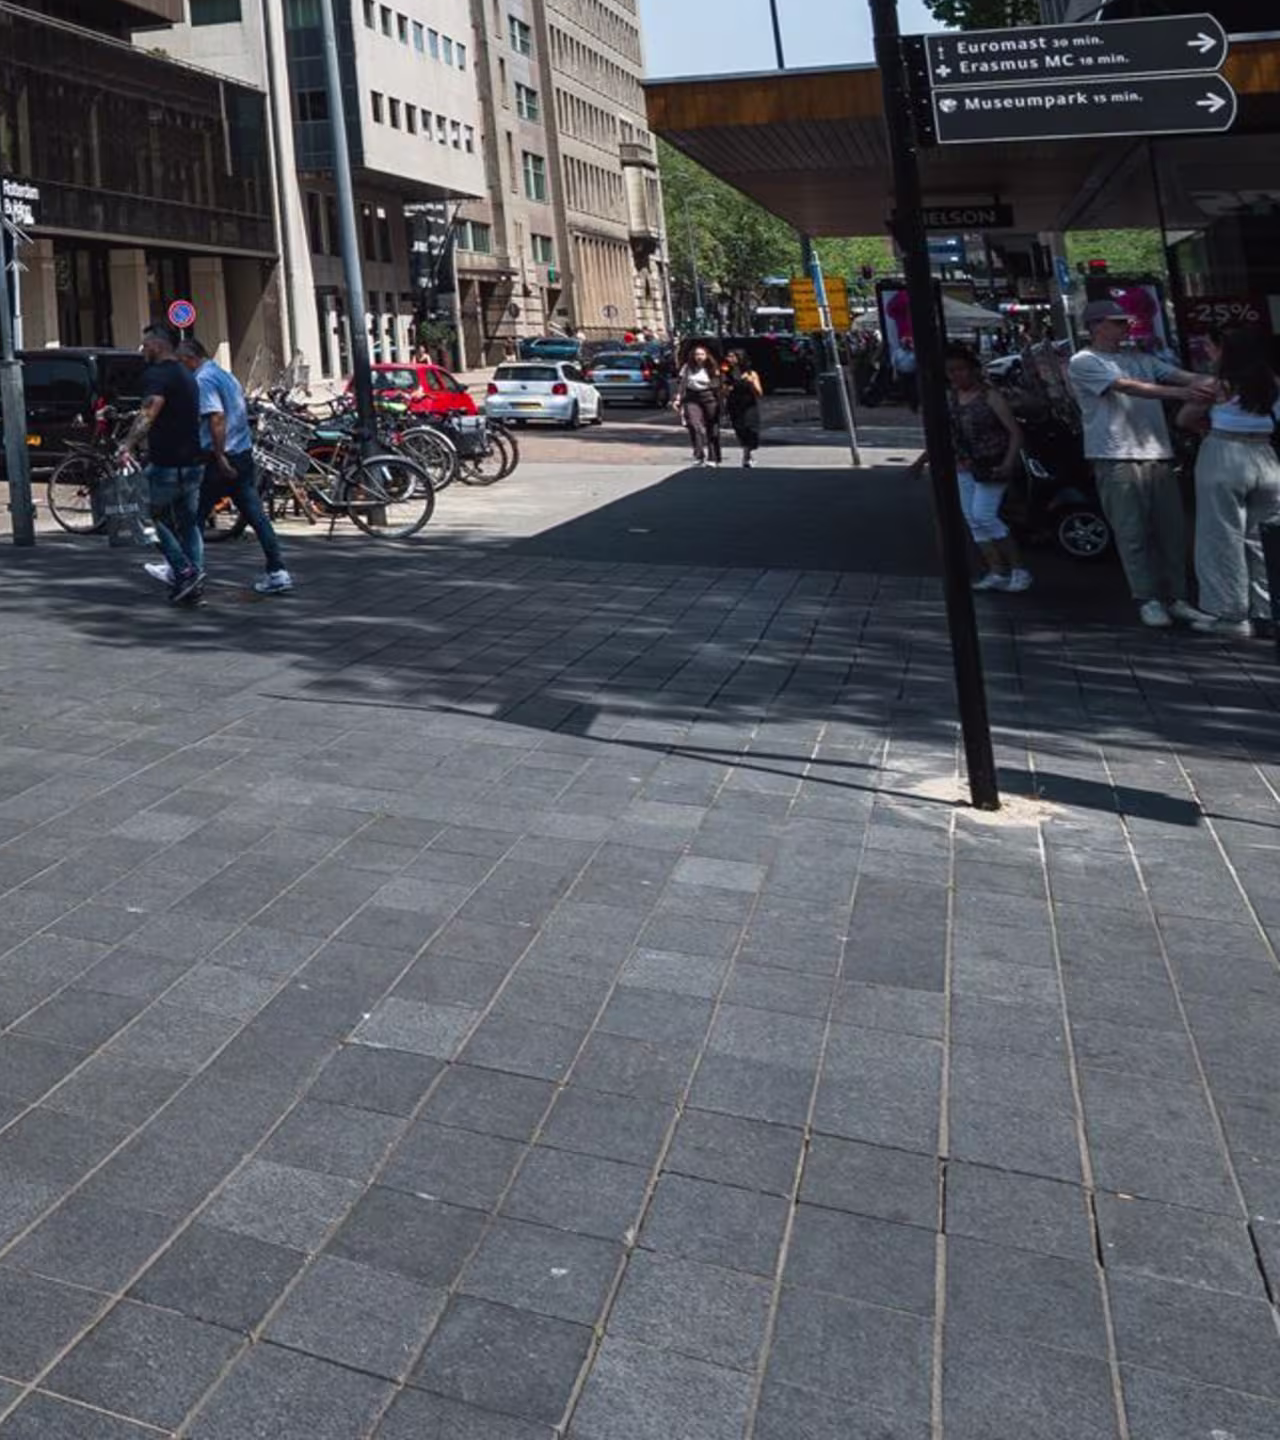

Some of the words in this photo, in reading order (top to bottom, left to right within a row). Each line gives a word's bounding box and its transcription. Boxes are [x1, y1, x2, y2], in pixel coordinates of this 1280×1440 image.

[957, 37, 1046, 54] Euromast
[1072, 35, 1105, 46] min.
[959, 58, 1039, 74] Erasmus
[1044, 55, 1075, 68] MC
[1097, 54, 1129, 64] min.
[964, 92, 1088, 111] Museumpark
[1110, 92, 1143, 102] min.
[922, 211, 996, 226] ELSON
